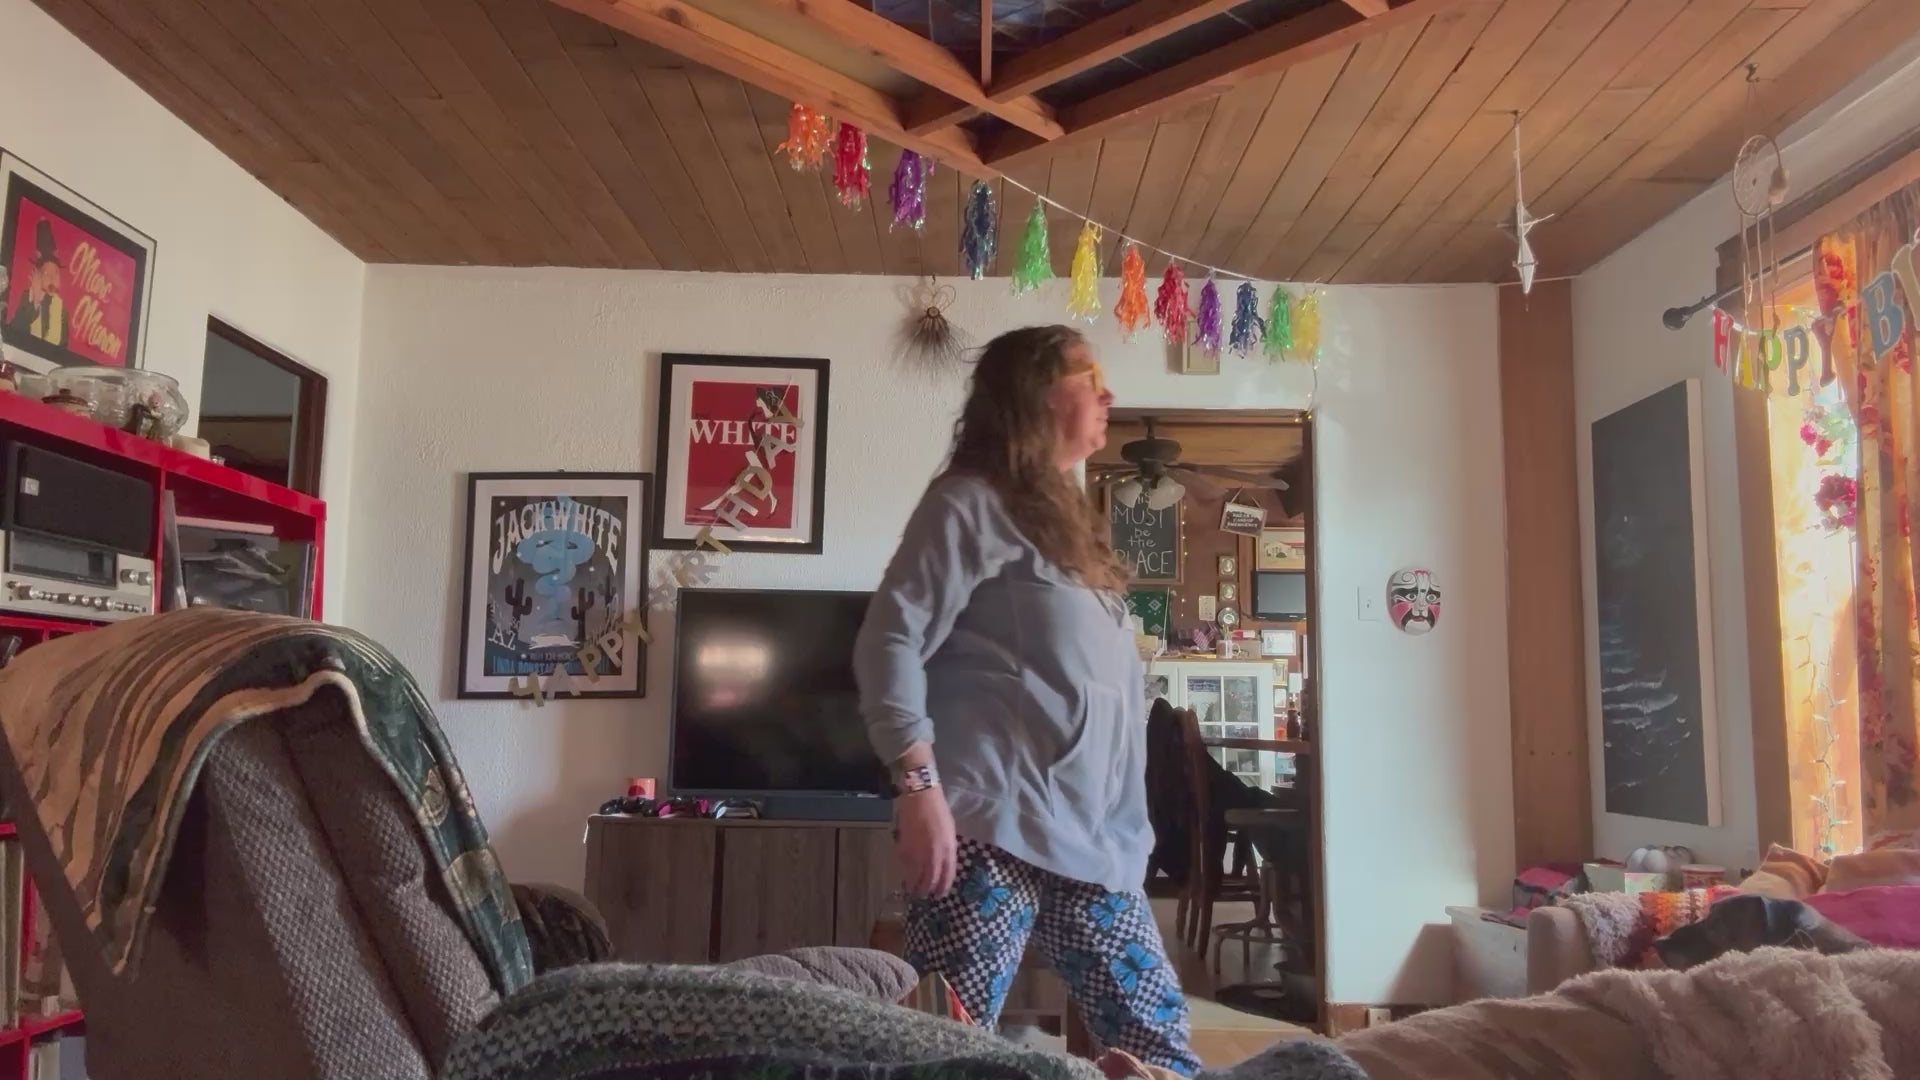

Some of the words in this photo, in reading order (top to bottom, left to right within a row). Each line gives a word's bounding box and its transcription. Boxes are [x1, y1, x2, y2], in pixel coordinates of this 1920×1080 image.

[1862, 226, 1920, 364] BI
[1113, 504, 1163, 529] MUST
[492, 500, 549, 575] JACK
[550, 500, 622, 577] WHITE
[1127, 535, 1157, 549] the
[1134, 527, 1152, 538] be
[1113, 548, 1174, 575] PLACE
